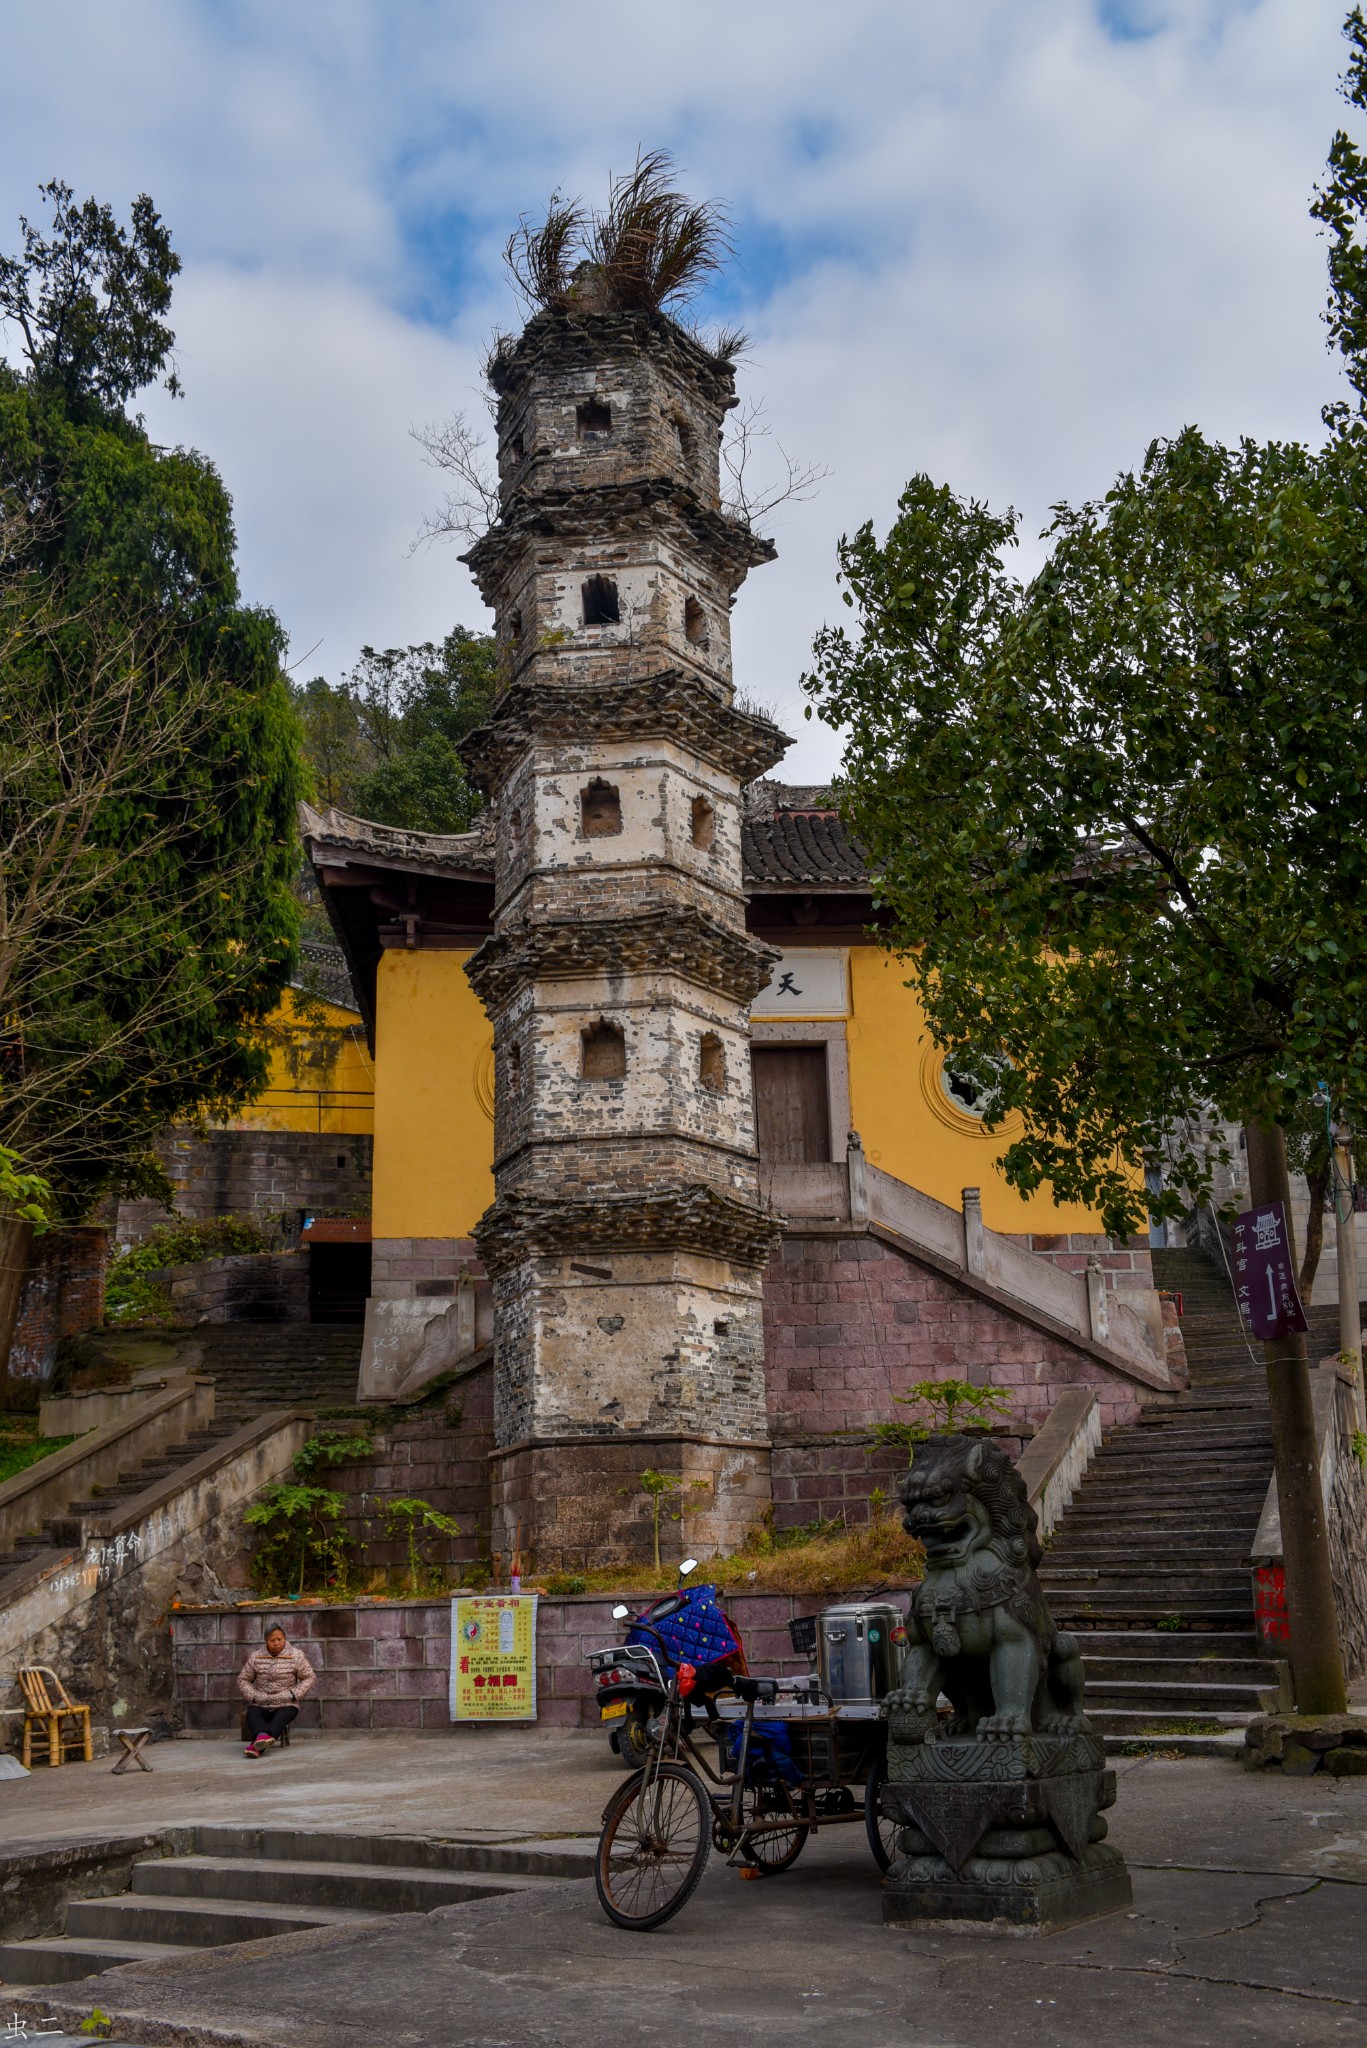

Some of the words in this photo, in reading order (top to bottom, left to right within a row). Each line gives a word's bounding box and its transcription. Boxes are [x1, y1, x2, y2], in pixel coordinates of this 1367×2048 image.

[775, 972, 803, 996] 天
[1234, 1224, 1248, 1272] 中斗宫
[471, 1598, 520, 1609] 专业看相
[460, 1656, 470, 1674] 看
